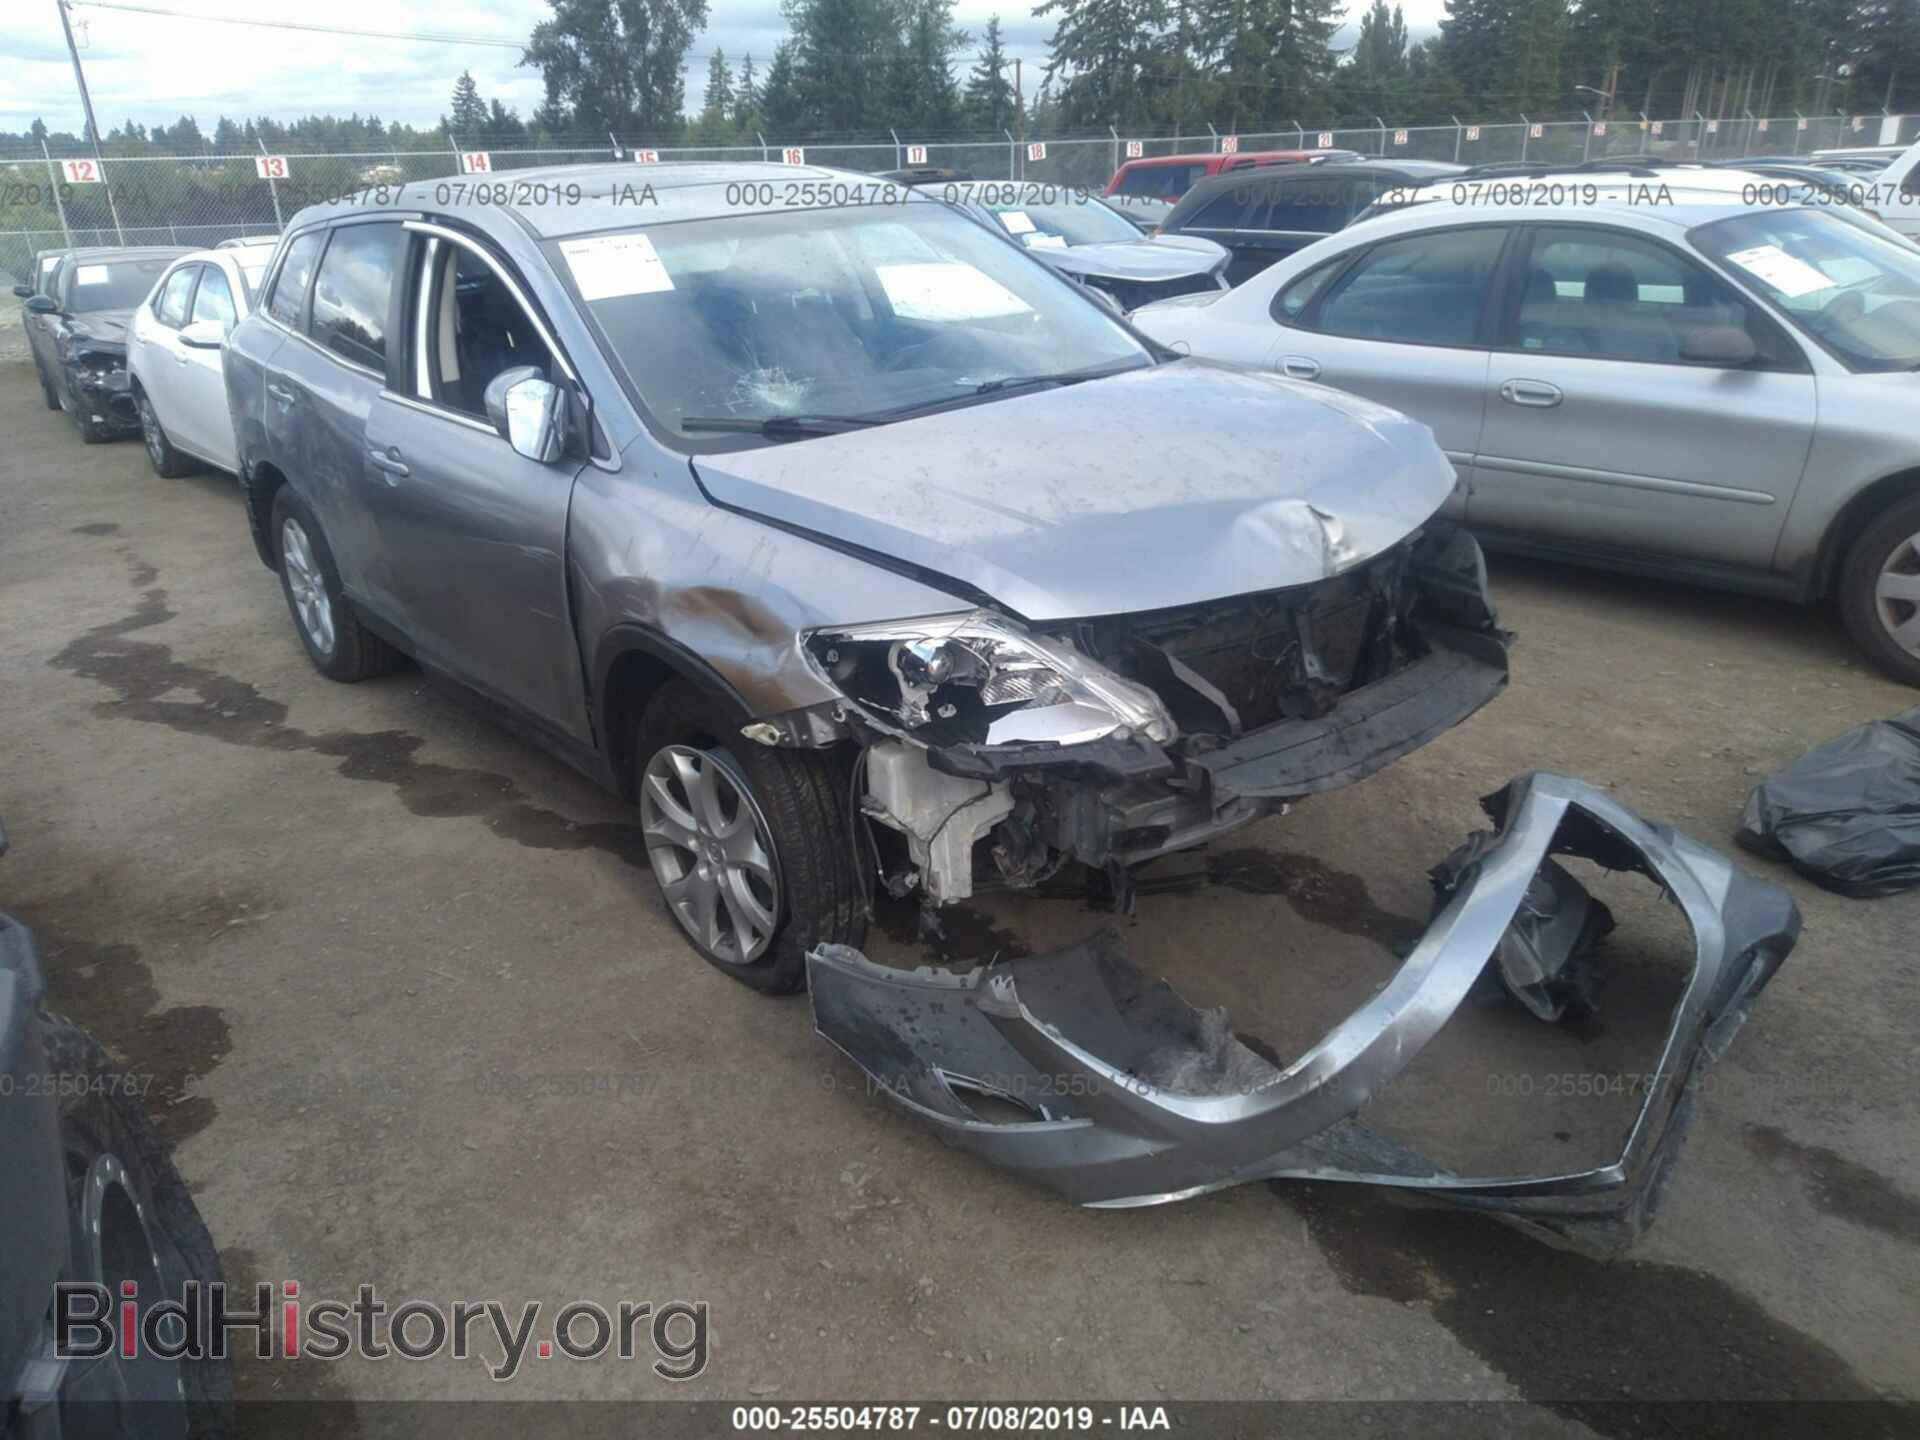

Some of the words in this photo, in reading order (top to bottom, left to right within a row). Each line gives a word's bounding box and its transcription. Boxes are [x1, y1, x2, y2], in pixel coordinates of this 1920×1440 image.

[786, 149, 801, 164] 16
[911, 147, 923, 162] 17
[1032, 144, 1043, 159] 18
[1130, 143, 1141, 156] 19
[261, 158, 284, 176] 13
[466, 154, 487, 171] 14
[68, 162, 95, 181] 12
